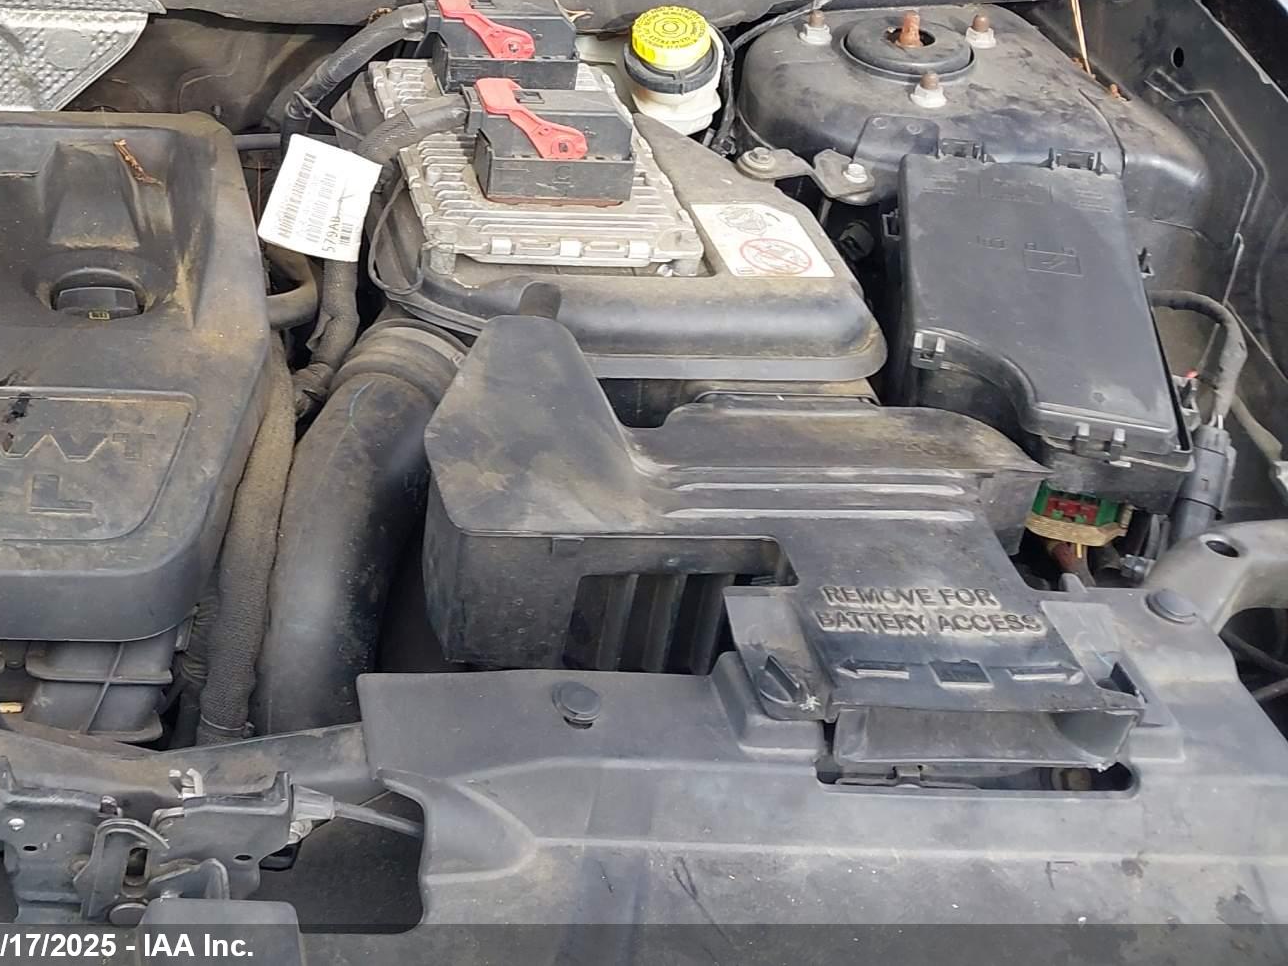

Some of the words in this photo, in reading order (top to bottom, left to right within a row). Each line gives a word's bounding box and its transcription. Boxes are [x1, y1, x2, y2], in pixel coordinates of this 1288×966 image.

[820, 585, 937, 610] REMOVE
[938, 587, 1001, 610] FOR
[814, 610, 928, 635] BATTERY
[936, 613, 1046, 636] ACCESS
